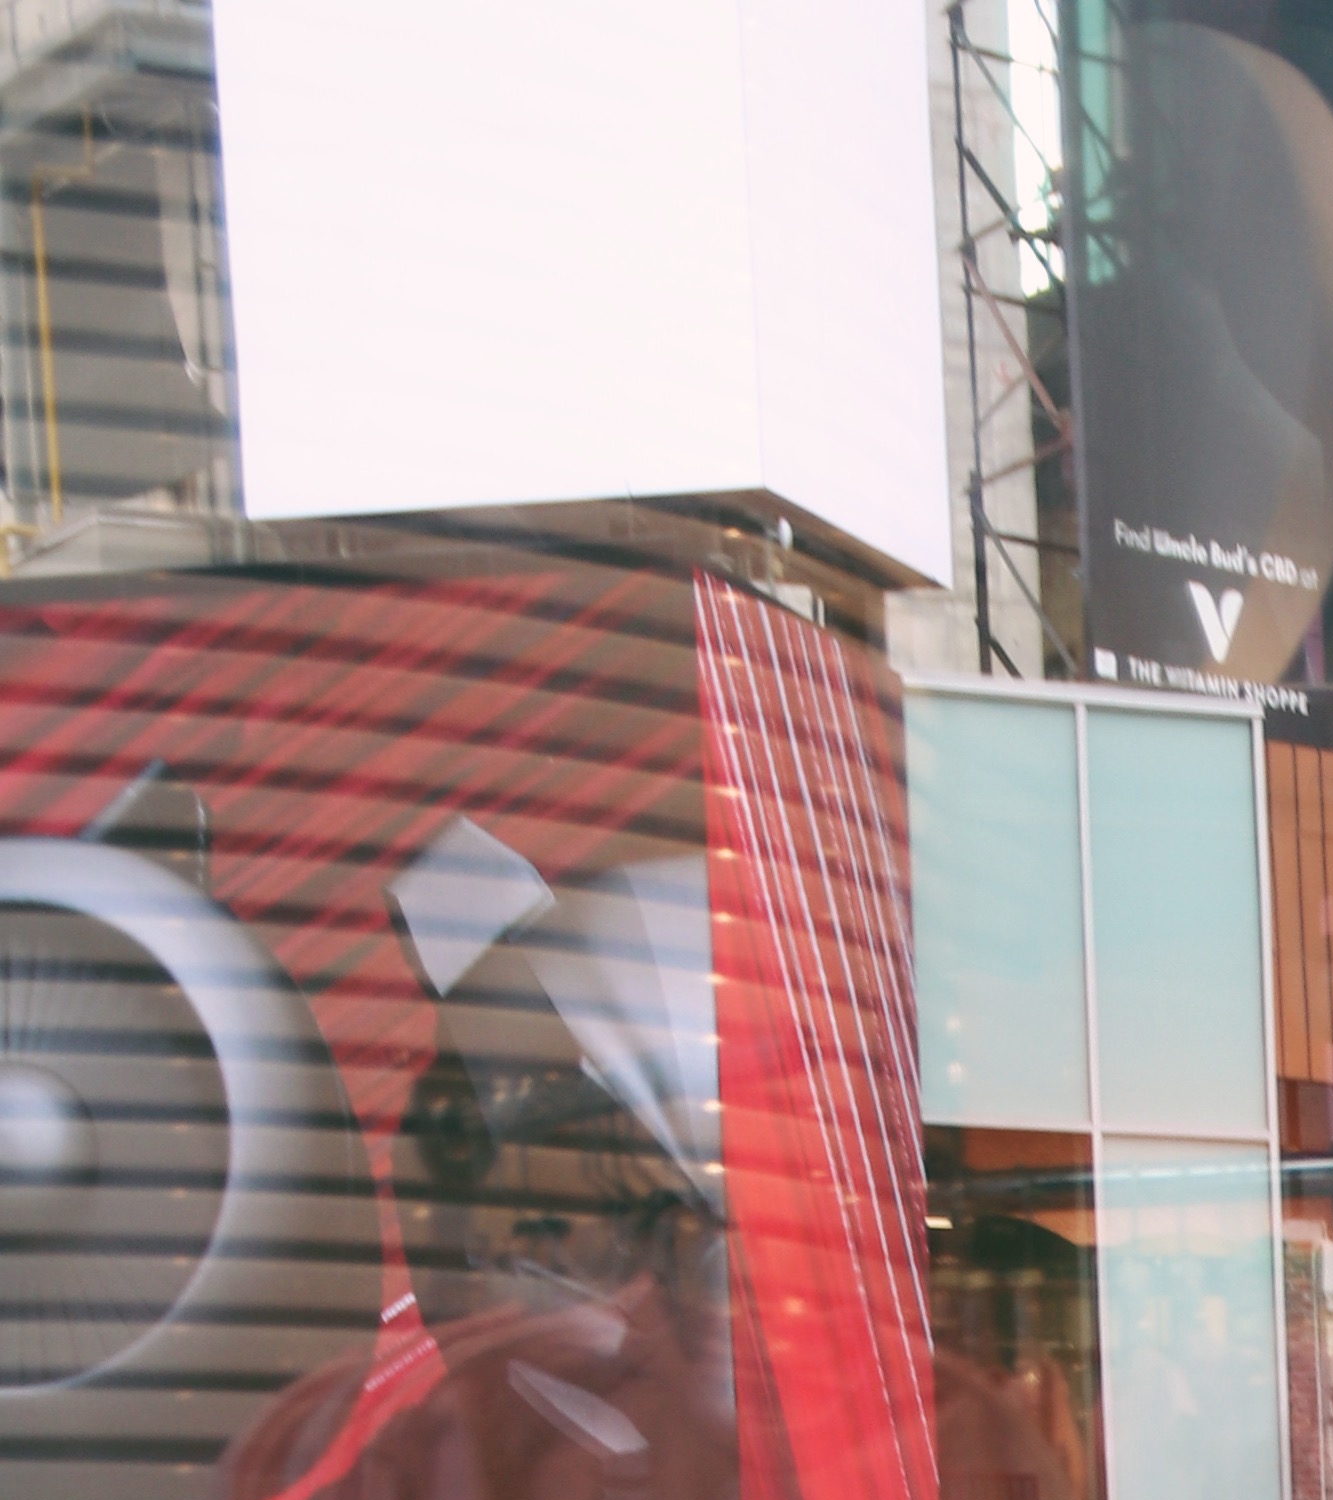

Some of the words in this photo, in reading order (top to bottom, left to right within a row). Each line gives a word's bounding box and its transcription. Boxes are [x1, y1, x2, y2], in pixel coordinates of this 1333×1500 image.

[1260, 552, 1297, 587] CBD
[1128, 657, 1162, 686] THE
[1166, 664, 1241, 702] VITAMIN
[1243, 680, 1311, 717] SHOPPE
